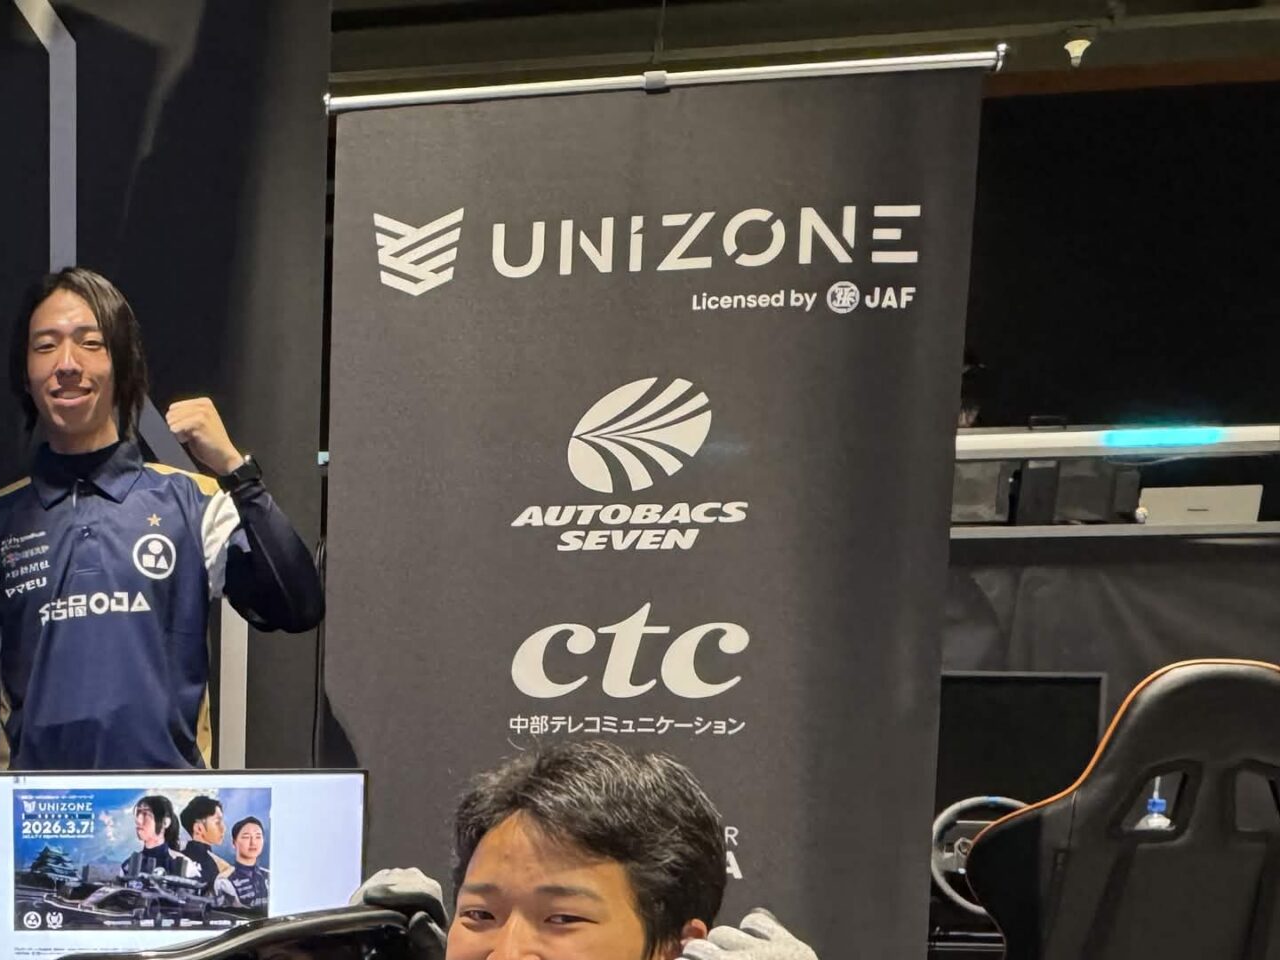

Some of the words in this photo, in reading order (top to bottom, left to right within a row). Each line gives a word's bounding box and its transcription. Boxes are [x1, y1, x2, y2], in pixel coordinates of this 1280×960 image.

[691, 289, 785, 311] Licensed
[790, 288, 818, 312] by
[864, 286, 917, 309] JAF
[510, 501, 749, 527] AUTOBACS
[556, 528, 700, 552] SEVEN
[511, 602, 750, 699] ctc
[509, 714, 747, 735] 中部テレコミュニケーション
[38, 802, 93, 811] UNIZONE
[22, 821, 89, 834] 2026.3.7
